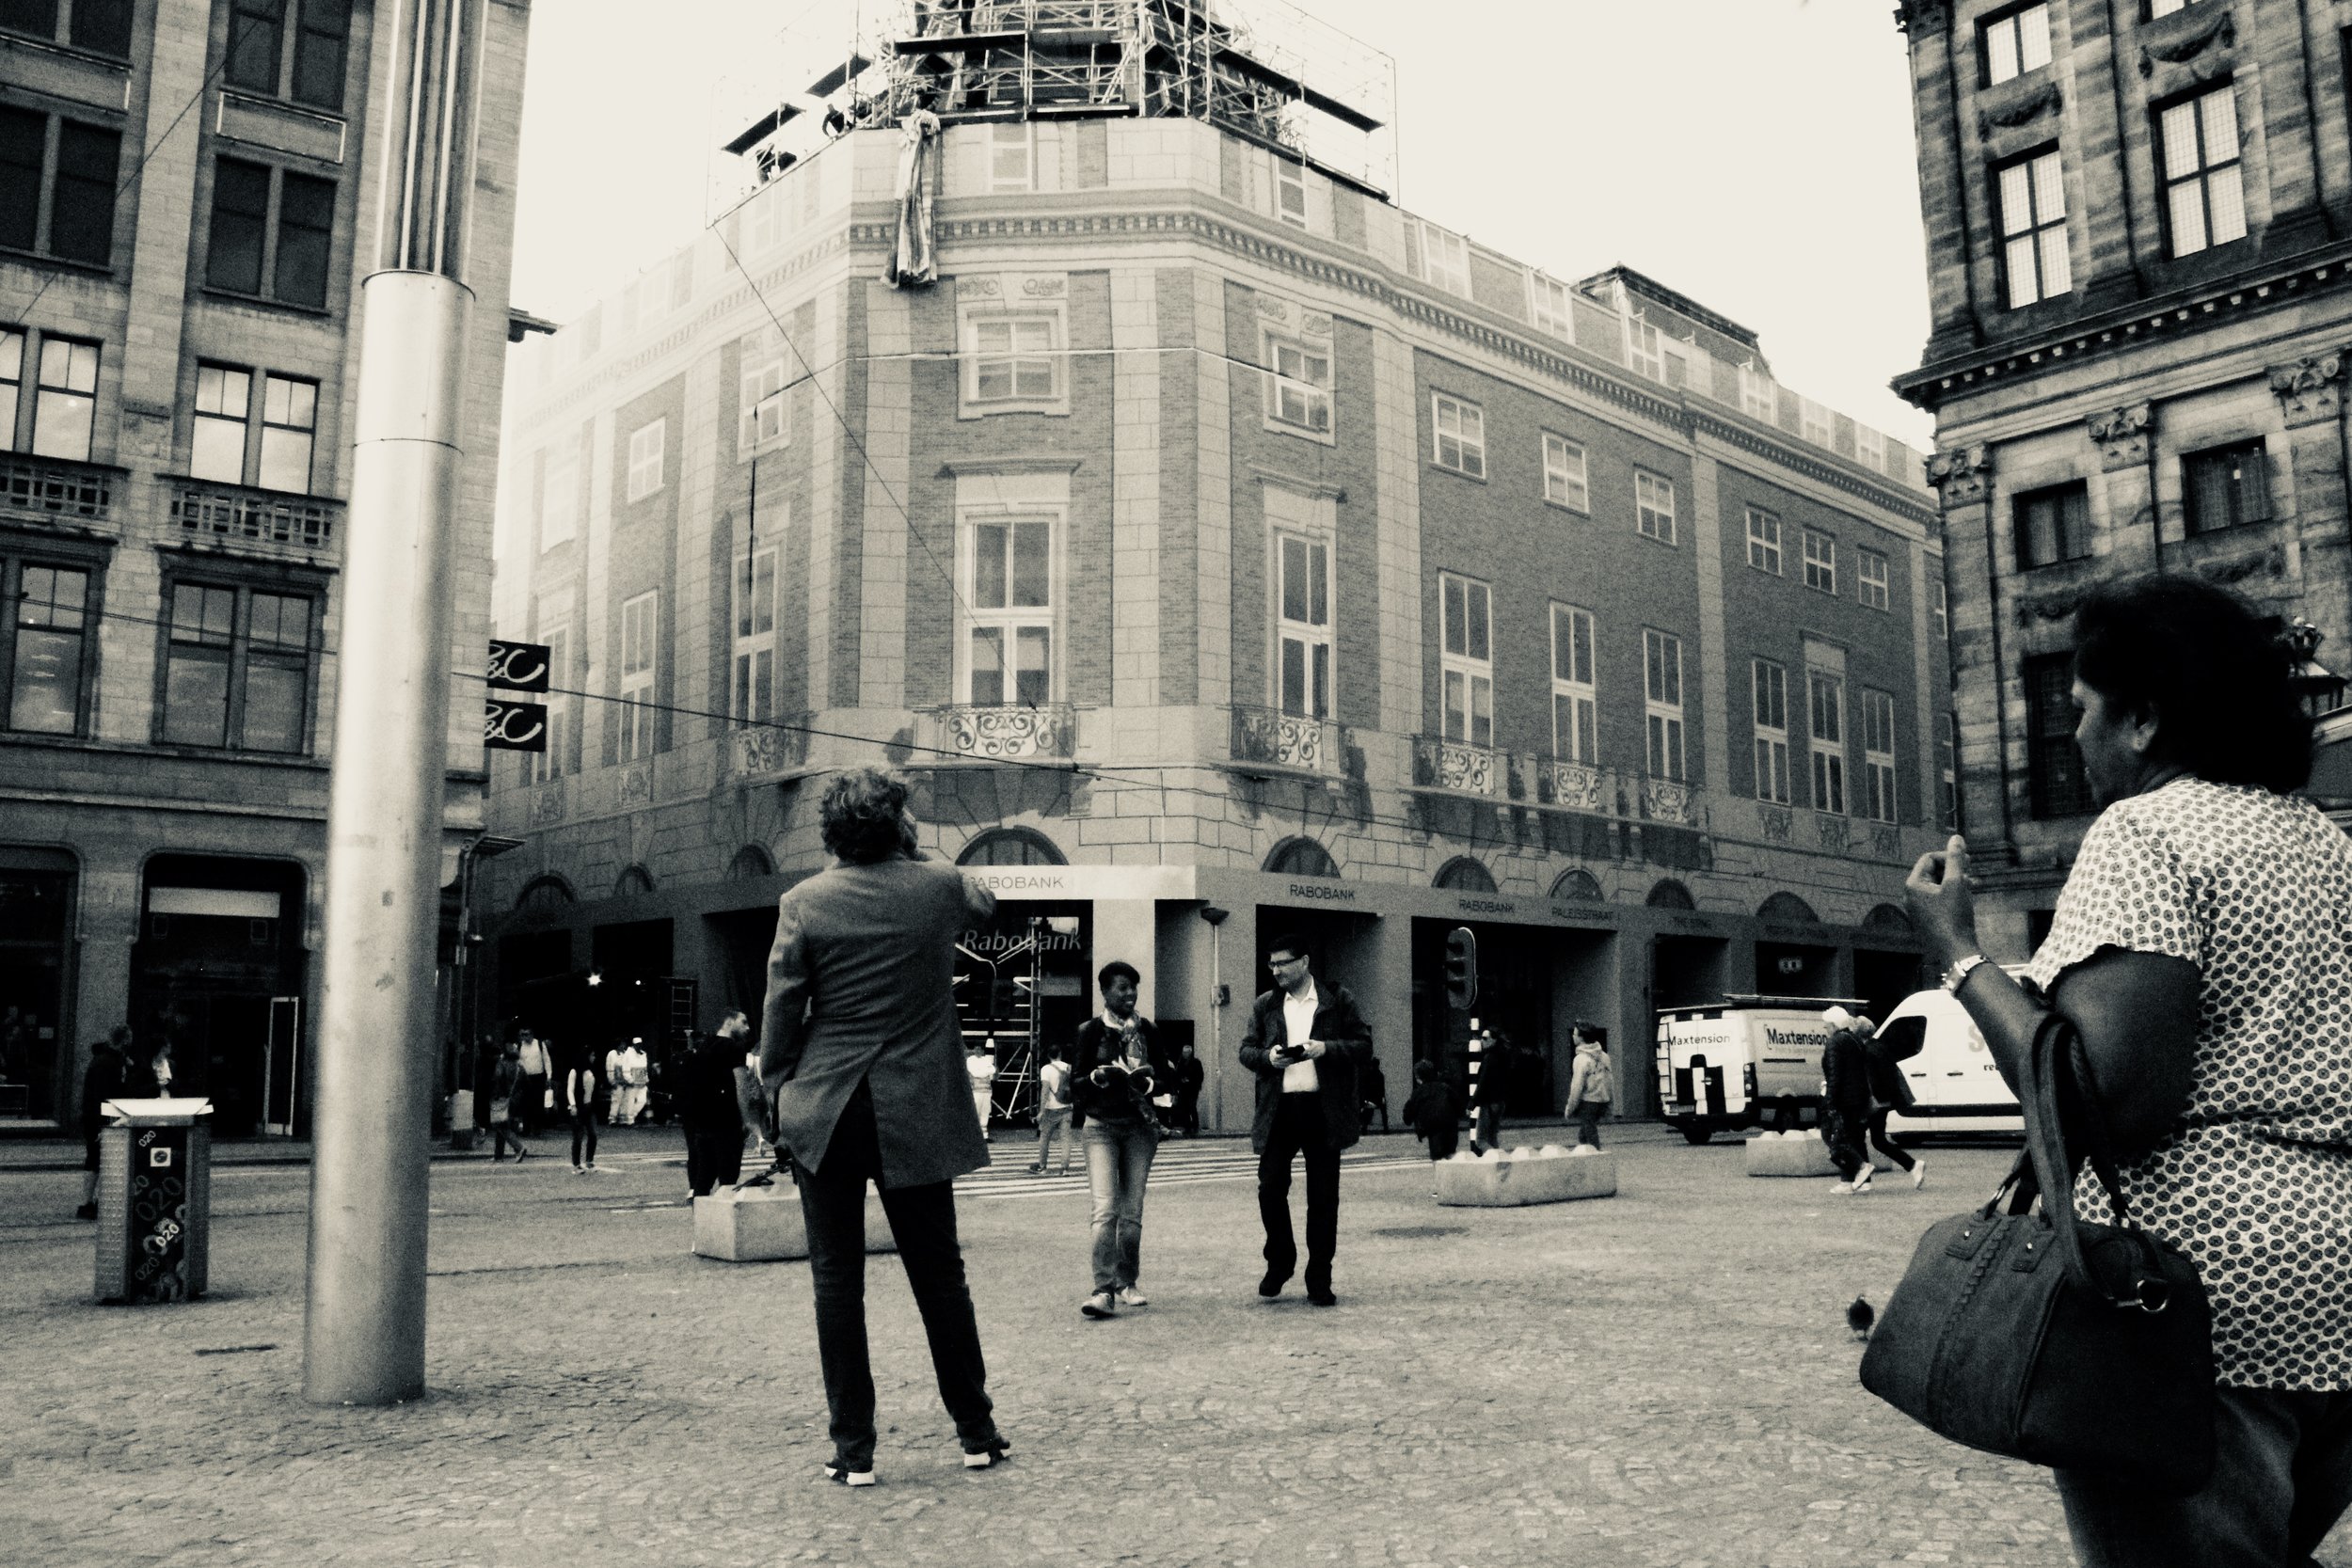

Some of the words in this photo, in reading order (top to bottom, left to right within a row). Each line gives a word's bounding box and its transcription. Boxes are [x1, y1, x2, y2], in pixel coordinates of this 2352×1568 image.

[1290, 884, 1355, 900] RABOBANK
[1459, 898, 1515, 913] RABOBANK
[963, 927, 1083, 952] Rabobank
[1668, 1034, 1730, 1046] Maxtension
[1767, 1028, 1827, 1046] Maxtension
[138, 1130, 156, 1148] 020
[155, 1223, 180, 1247] 020
